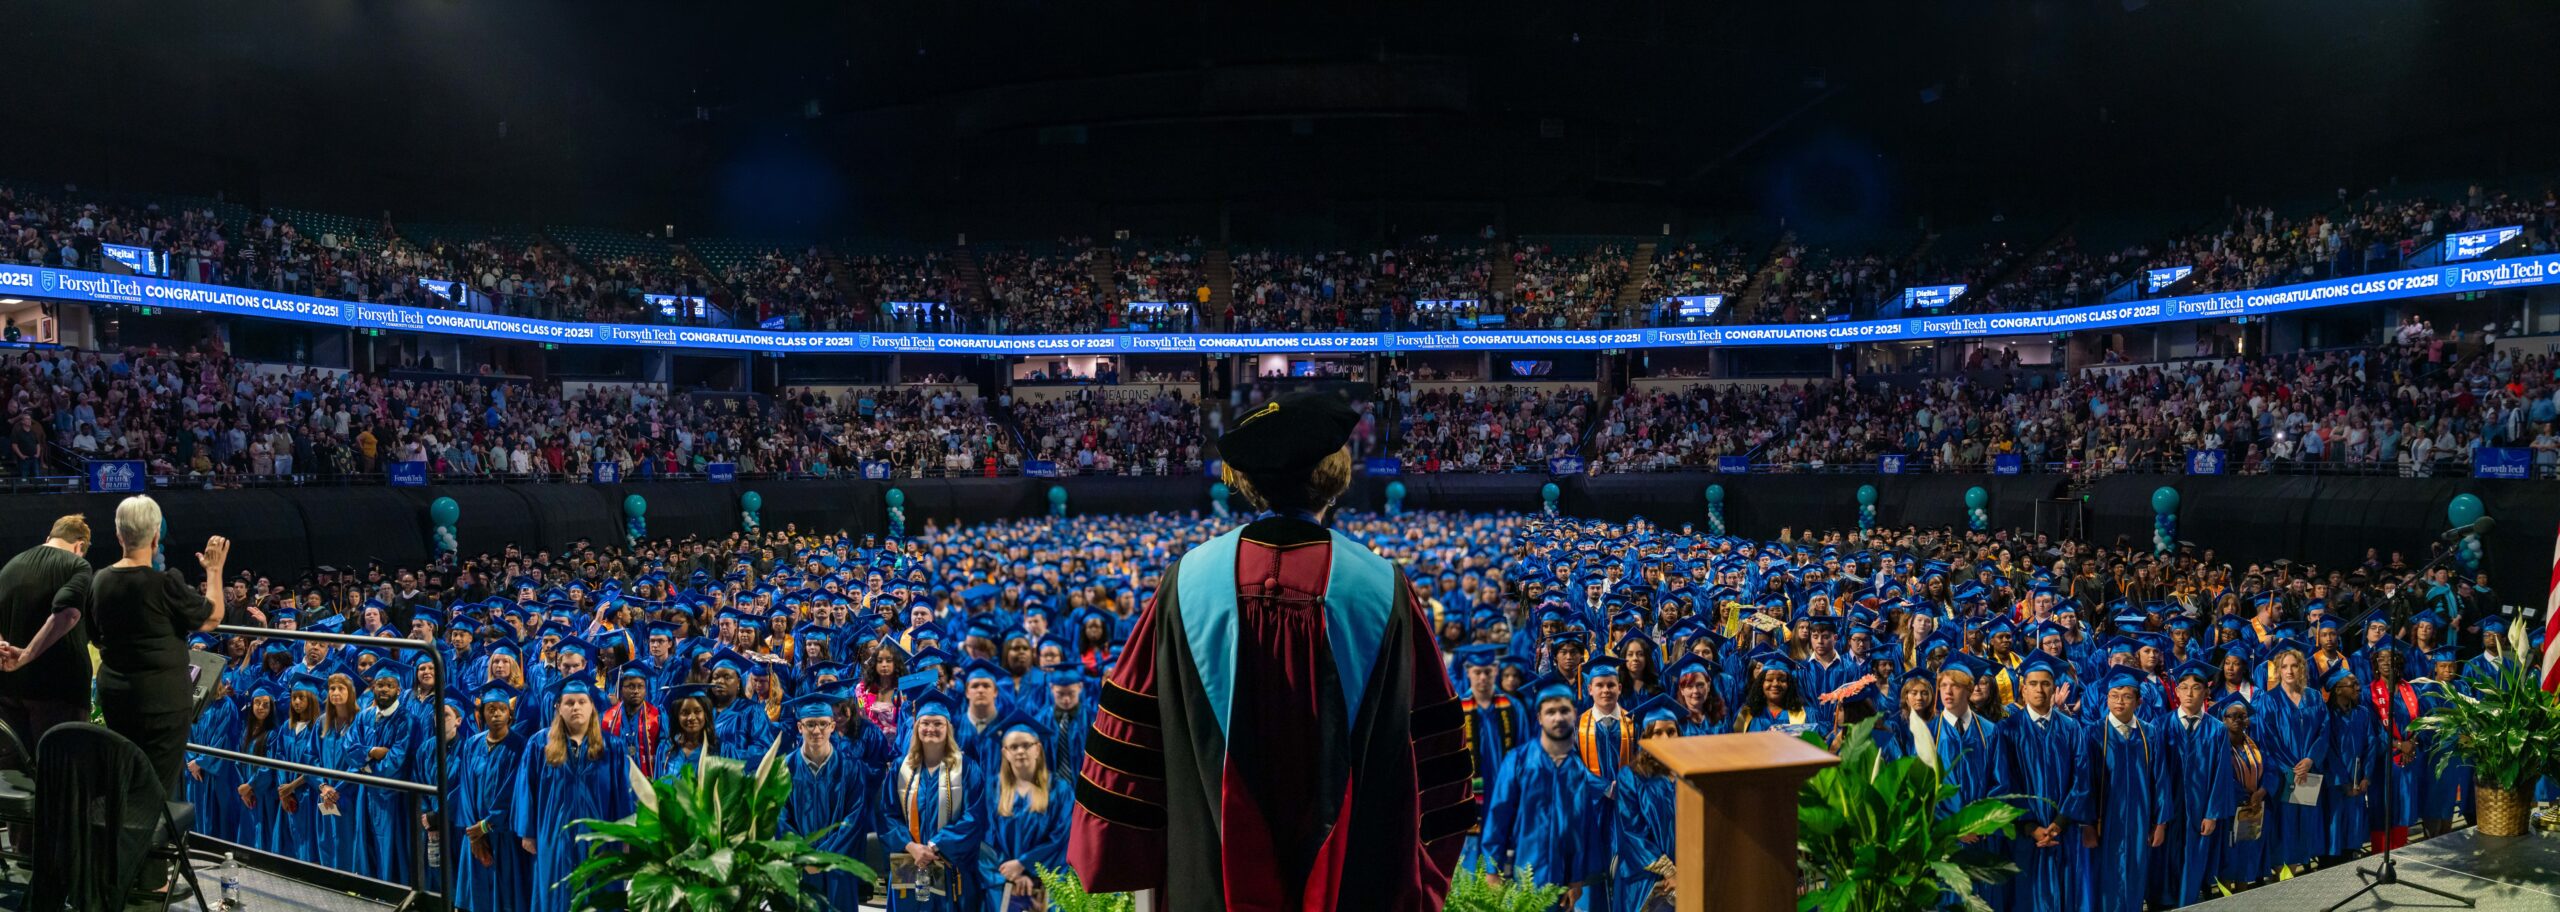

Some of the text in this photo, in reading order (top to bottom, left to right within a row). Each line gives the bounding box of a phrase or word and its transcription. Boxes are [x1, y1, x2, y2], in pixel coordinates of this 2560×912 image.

[108, 248, 135, 259] Digital
[2461, 264, 2511, 285] Forsyth
[2511, 261, 2543, 278] Tech
[59, 274, 141, 296] Forsyth Tech
[2248, 274, 2438, 306] CONGRATULATIONS CLASS OF 2025!
[146, 285, 338, 316] CONGRATULATIONS CLASS OF 2025!
[2179, 295, 2243, 313] Forsyth Tech
[357, 307, 423, 324] Forsyth Tech
[1991, 306, 2160, 328] CONGRATULATIONS CLASS OF 2025!
[427, 315, 593, 337] CONGRATULATIONS CLASS OF 2025!
[1725, 325, 1901, 339] CONGRATULATIONS CLASS OF 2025!
[1924, 318, 1986, 333] Forsyth Tech
[613, 327, 676, 341] Forsyth Tech
[680, 332, 773, 344] CONGRATULATIONS
[775, 337, 806, 345] CLASS
[1396, 334, 1459, 347] Forsyth Tech
[1463, 336, 1562, 344] CONGRATULATIONS
[1599, 335, 1612, 343] OF
[1615, 334, 1640, 342] 2025!
[1659, 329, 1721, 343] Forsyth Tech
[872, 336, 934, 348] Forsyth Tech
[938, 339, 1035, 348] CONGRATULATIONS
[1038, 340, 1069, 348] CLASS
[1087, 339, 1114, 347] 2025!
[1134, 336, 1195, 348] Forsyth Tech
[1199, 338, 1299, 346] CONGRATULATIONS
[1301, 338, 1332, 346] CLASS
[2481, 464, 2524, 474] Forsyth Tech
